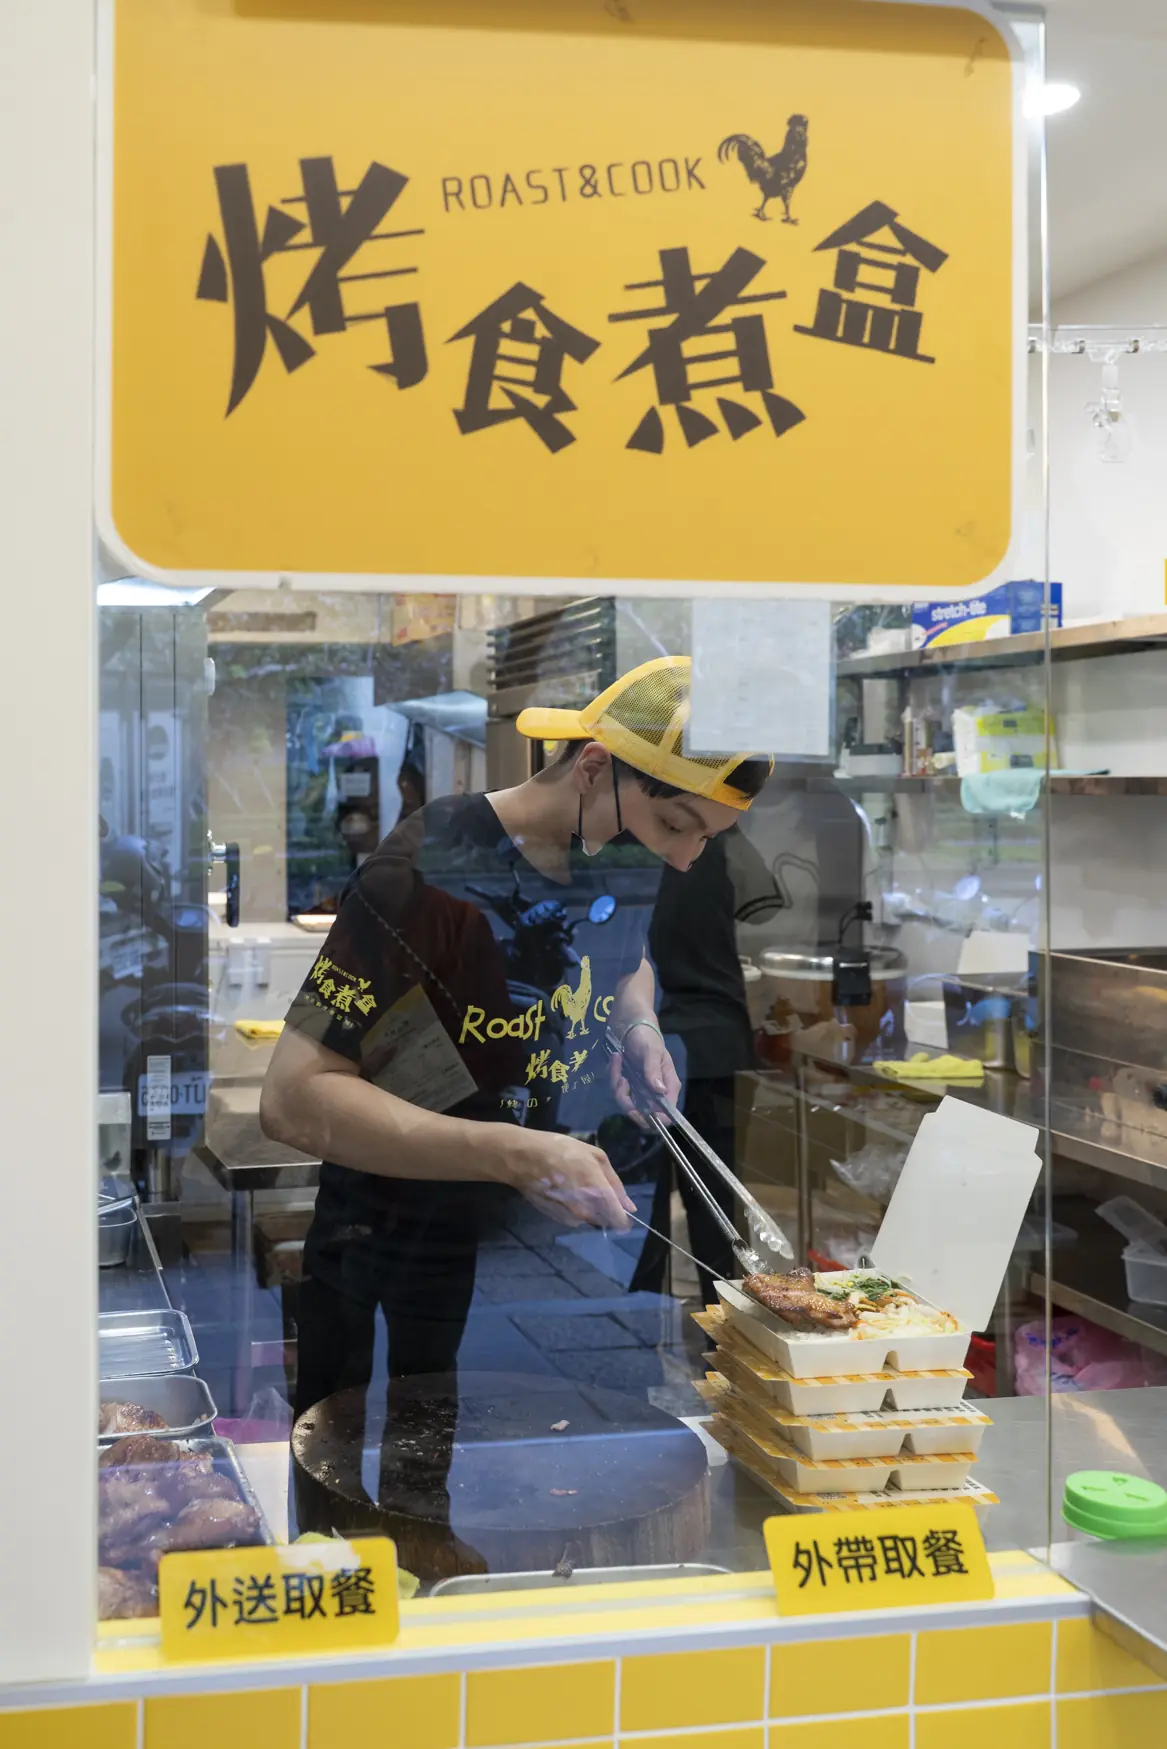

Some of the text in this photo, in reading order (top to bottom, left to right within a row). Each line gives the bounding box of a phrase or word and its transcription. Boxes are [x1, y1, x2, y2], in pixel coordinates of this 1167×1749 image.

[442, 157, 706, 213] ROAST&COOK
[196, 156, 948, 454] 烤食煮盒
[458, 1000, 546, 1044] Roast
[793, 1529, 968, 1588] 外帶取餐
[183, 1567, 376, 1630] 外送取餐
